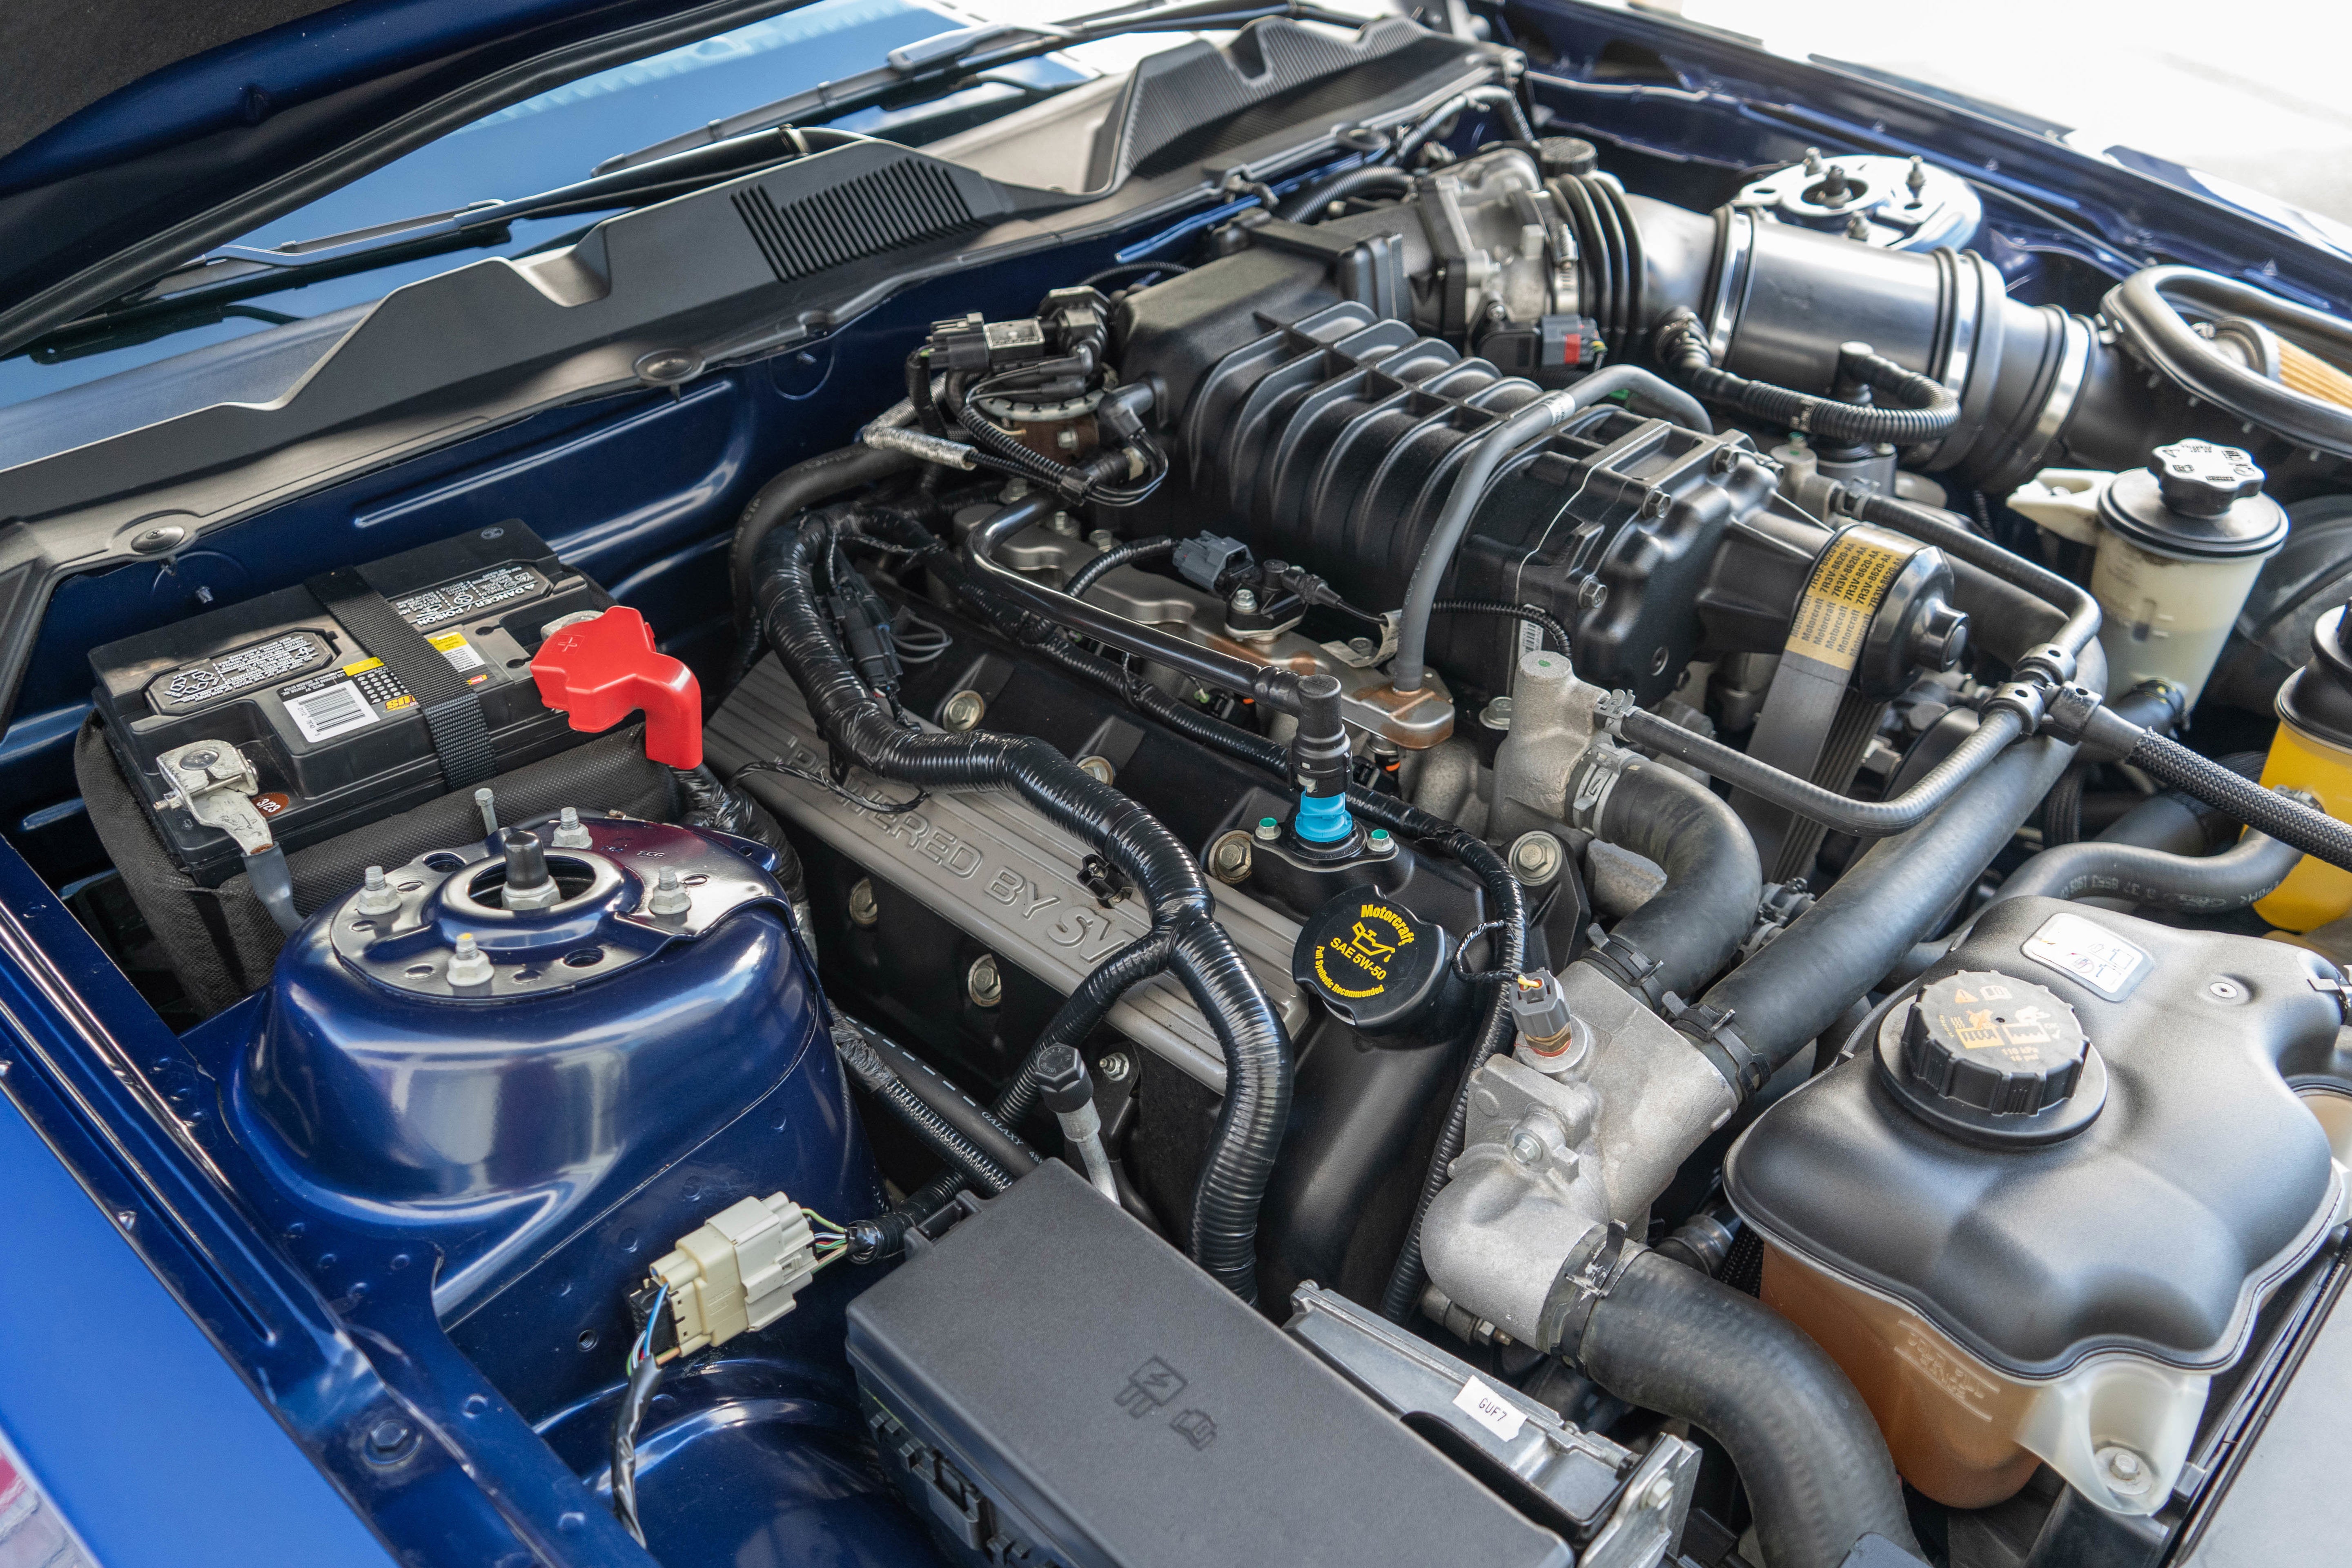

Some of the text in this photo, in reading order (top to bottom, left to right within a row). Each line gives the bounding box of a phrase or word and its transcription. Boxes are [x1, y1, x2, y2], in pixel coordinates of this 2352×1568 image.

[474, 587, 525, 608] DANGER
[1802, 542, 1854, 641] Motorcraft 7R3V-8620-AA
[1813, 546, 1866, 644] Motorcraft 7R3V-8620-AA
[1825, 550, 1879, 648] Motorcraft 7R3V-8620-AA
[1837, 553, 1891, 653] Motorcraft 7R3V-8620-AA
[416, 607, 463, 627] POISON
[256, 798, 281, 812] 3/23
[784, 741, 987, 884] PWERED
[983, 868, 1060, 920] BY
[1361, 903, 1415, 947] Motorcraft
[1315, 945, 1385, 998] Full Synthetic Recommended
[1330, 937, 1387, 980] SAE 5W-50
[1479, 1397, 1507, 1423] GUF7
